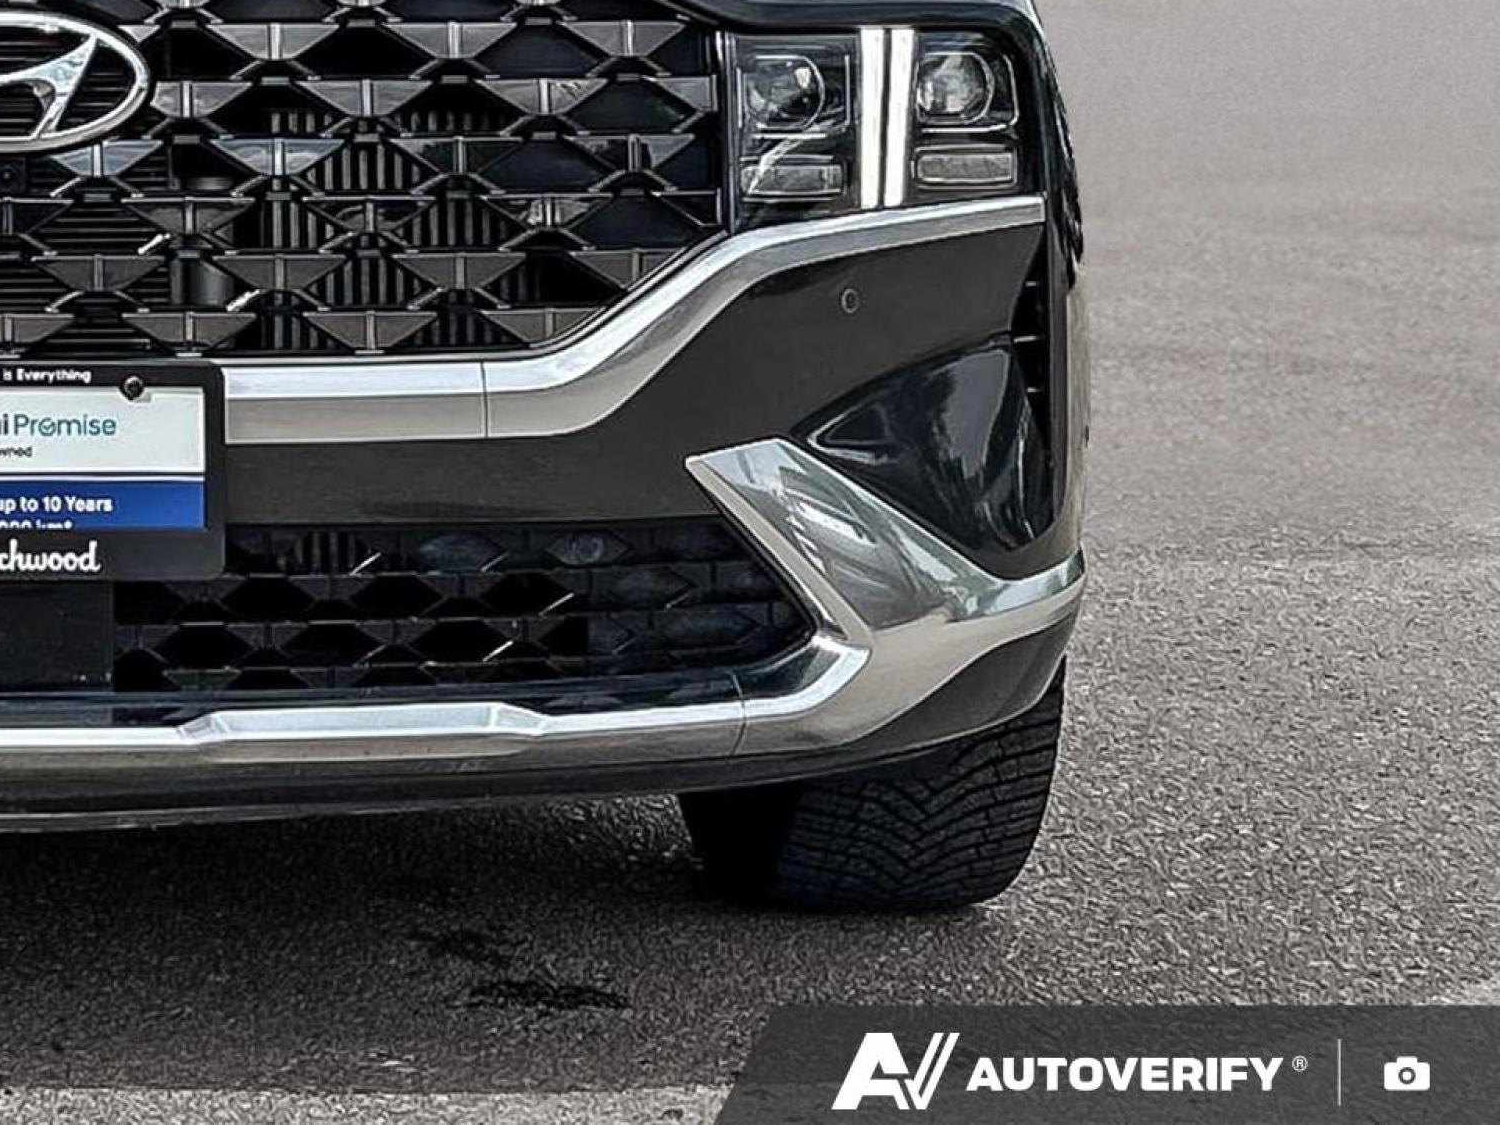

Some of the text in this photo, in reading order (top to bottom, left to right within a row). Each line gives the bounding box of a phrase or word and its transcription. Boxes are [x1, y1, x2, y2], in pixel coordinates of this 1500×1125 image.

[16, 369, 92, 383] Everything
[13, 413, 117, 436] Promise
[19, 496, 40, 512] to
[41, 496, 62, 512] 10
[64, 496, 114, 512] Years
